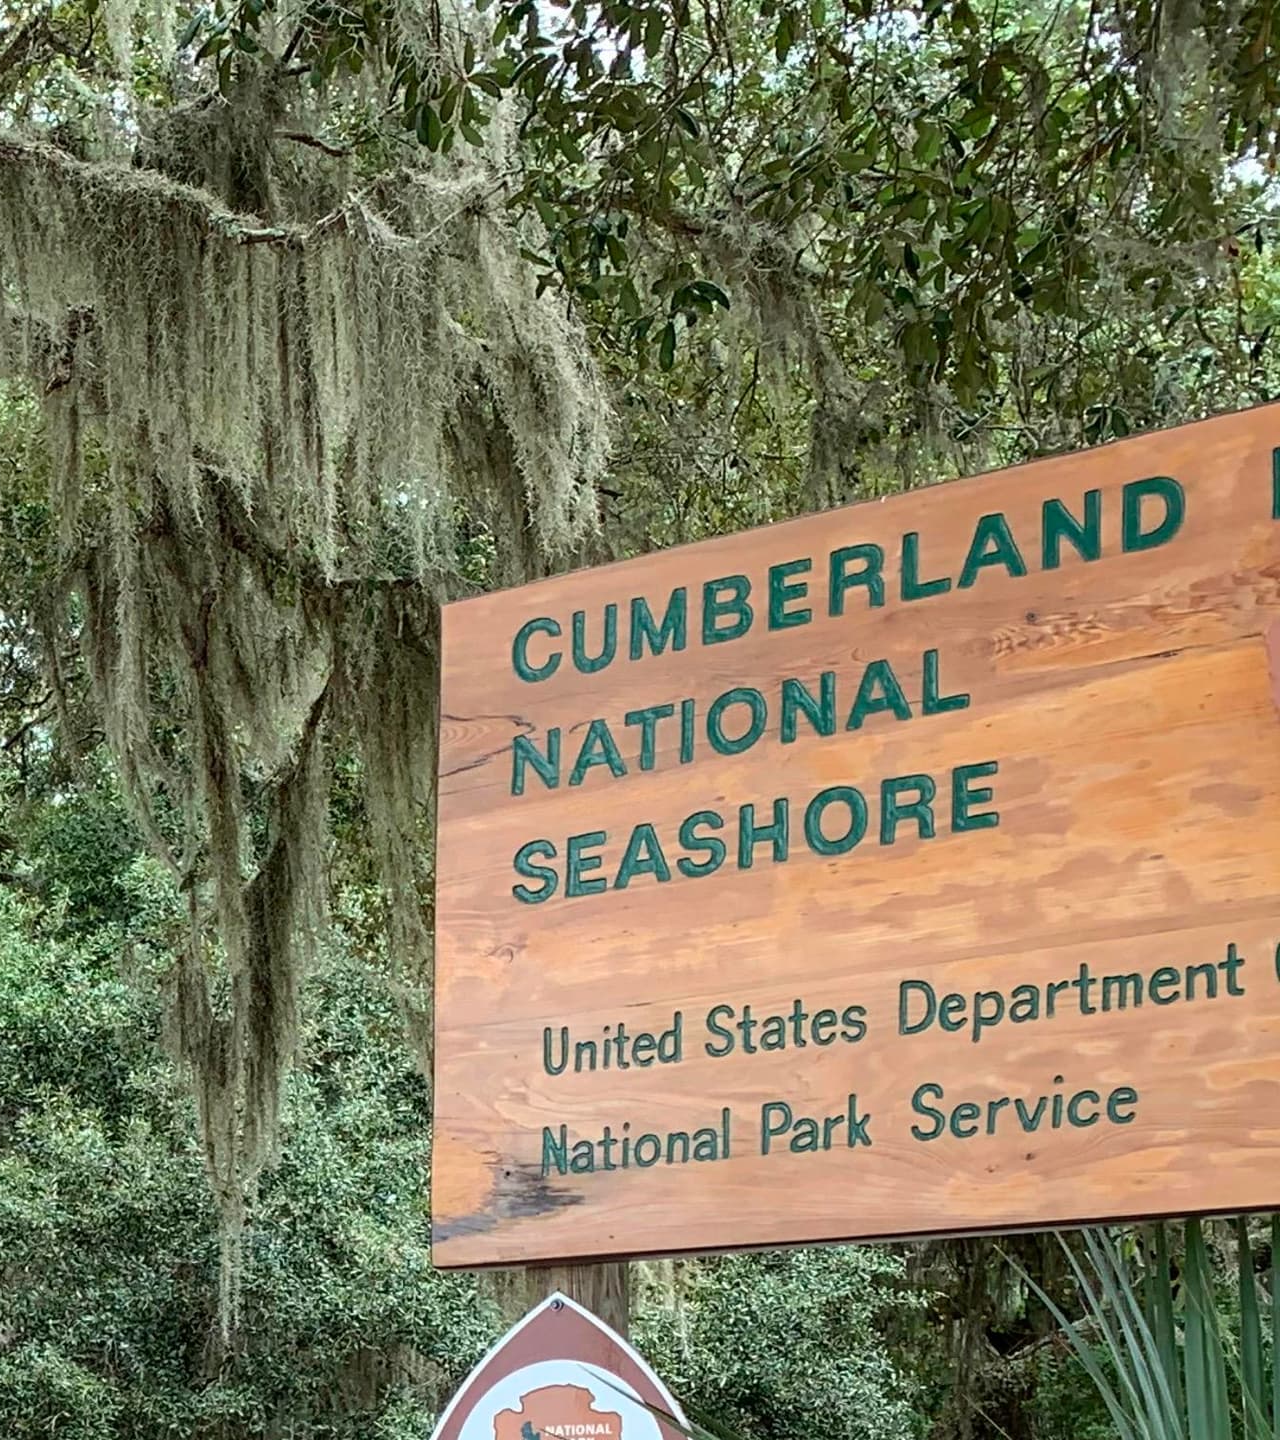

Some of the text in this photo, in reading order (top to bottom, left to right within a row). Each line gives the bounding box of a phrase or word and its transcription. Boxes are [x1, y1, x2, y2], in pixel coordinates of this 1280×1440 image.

[512, 475, 1185, 683] CUMBERLAND
[511, 648, 971, 797] NATIONAL
[511, 760, 1001, 905] SEASHORE
[542, 1012, 683, 1077] United
[703, 996, 867, 1058] States
[898, 942, 1245, 1045] Department
[540, 1074, 1139, 1177] National Park Service
[545, 1423, 613, 1436] NATIONAL
